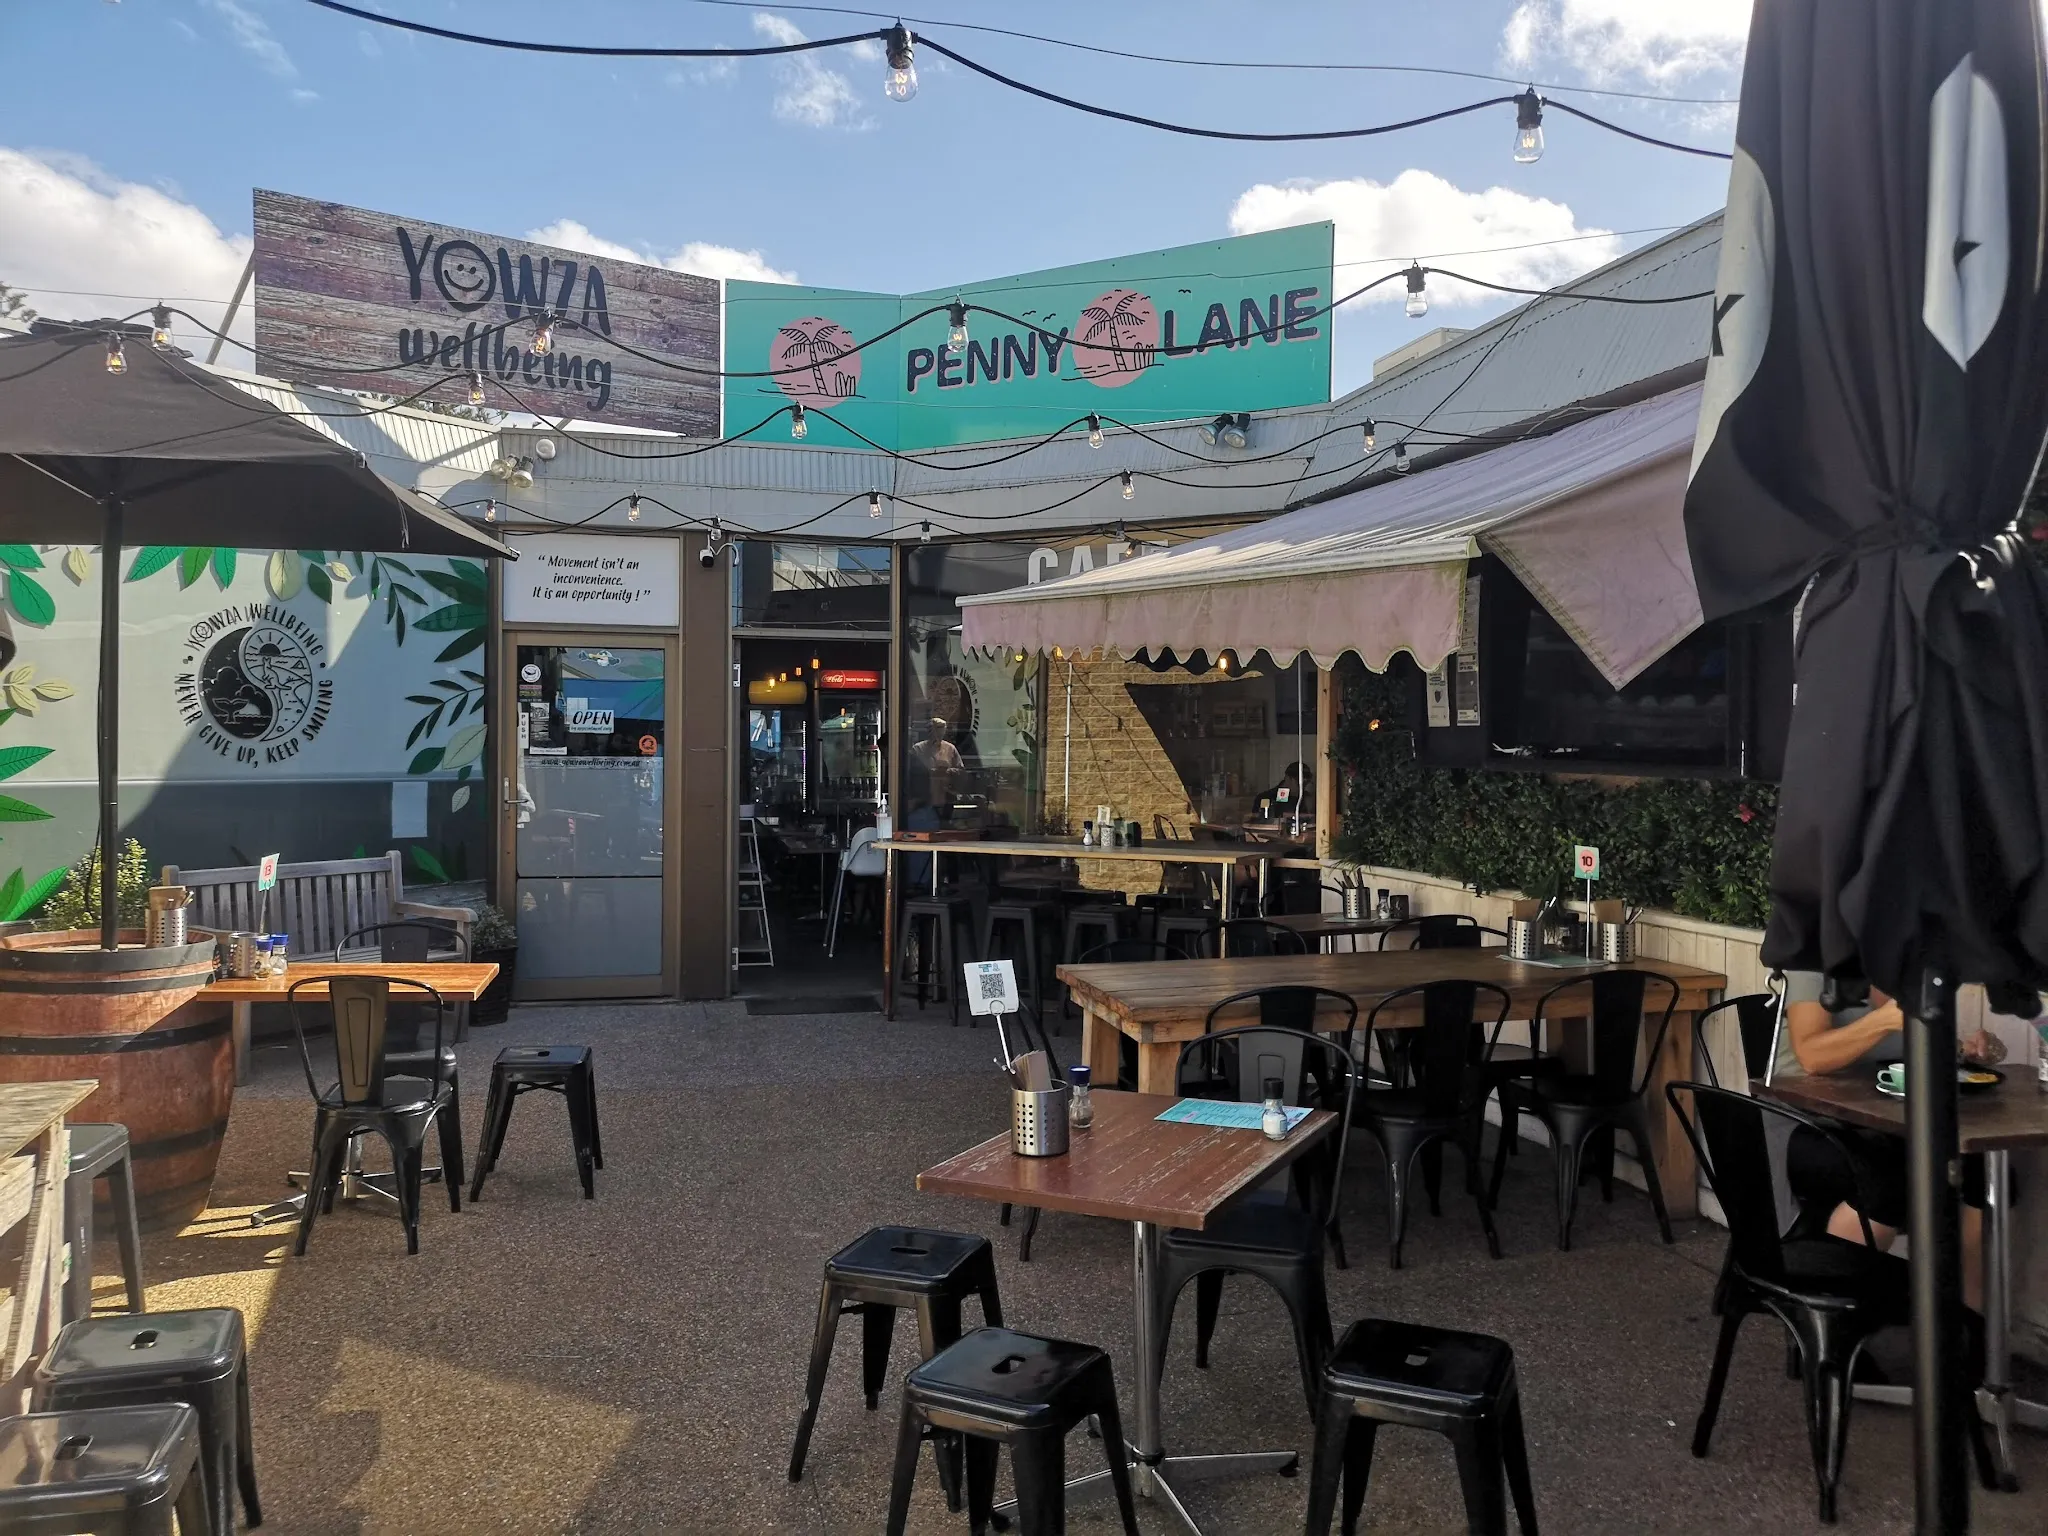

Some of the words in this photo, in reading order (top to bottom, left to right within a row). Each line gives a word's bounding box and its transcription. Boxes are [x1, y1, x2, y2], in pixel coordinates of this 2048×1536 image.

[397, 227, 611, 337] YOWZA
[906, 326, 1069, 393] PENNY
[1164, 286, 1319, 357] LANE
[399, 321, 612, 411] wellbeing
[547, 555, 599, 570] Movement
[601, 558, 624, 570] isn't
[626, 560, 639, 571] an
[553, 572, 623, 586] inconvenience.
[532, 586, 541, 598] It
[544, 587, 554, 600] is
[555, 588, 568, 599] an
[571, 587, 632, 604] opportunity
[184, 605, 242, 651] YOWZA
[249, 602, 324, 656] WELLBEING
[174, 673, 203, 727] NEVER
[199, 724, 233, 757] GIVE
[237, 745, 260, 768] UP,
[267, 737, 300, 764] KEEP
[302, 679, 334, 741] SMILING
[572, 710, 612, 725] OPEN
[1581, 855, 1593, 867] 10
